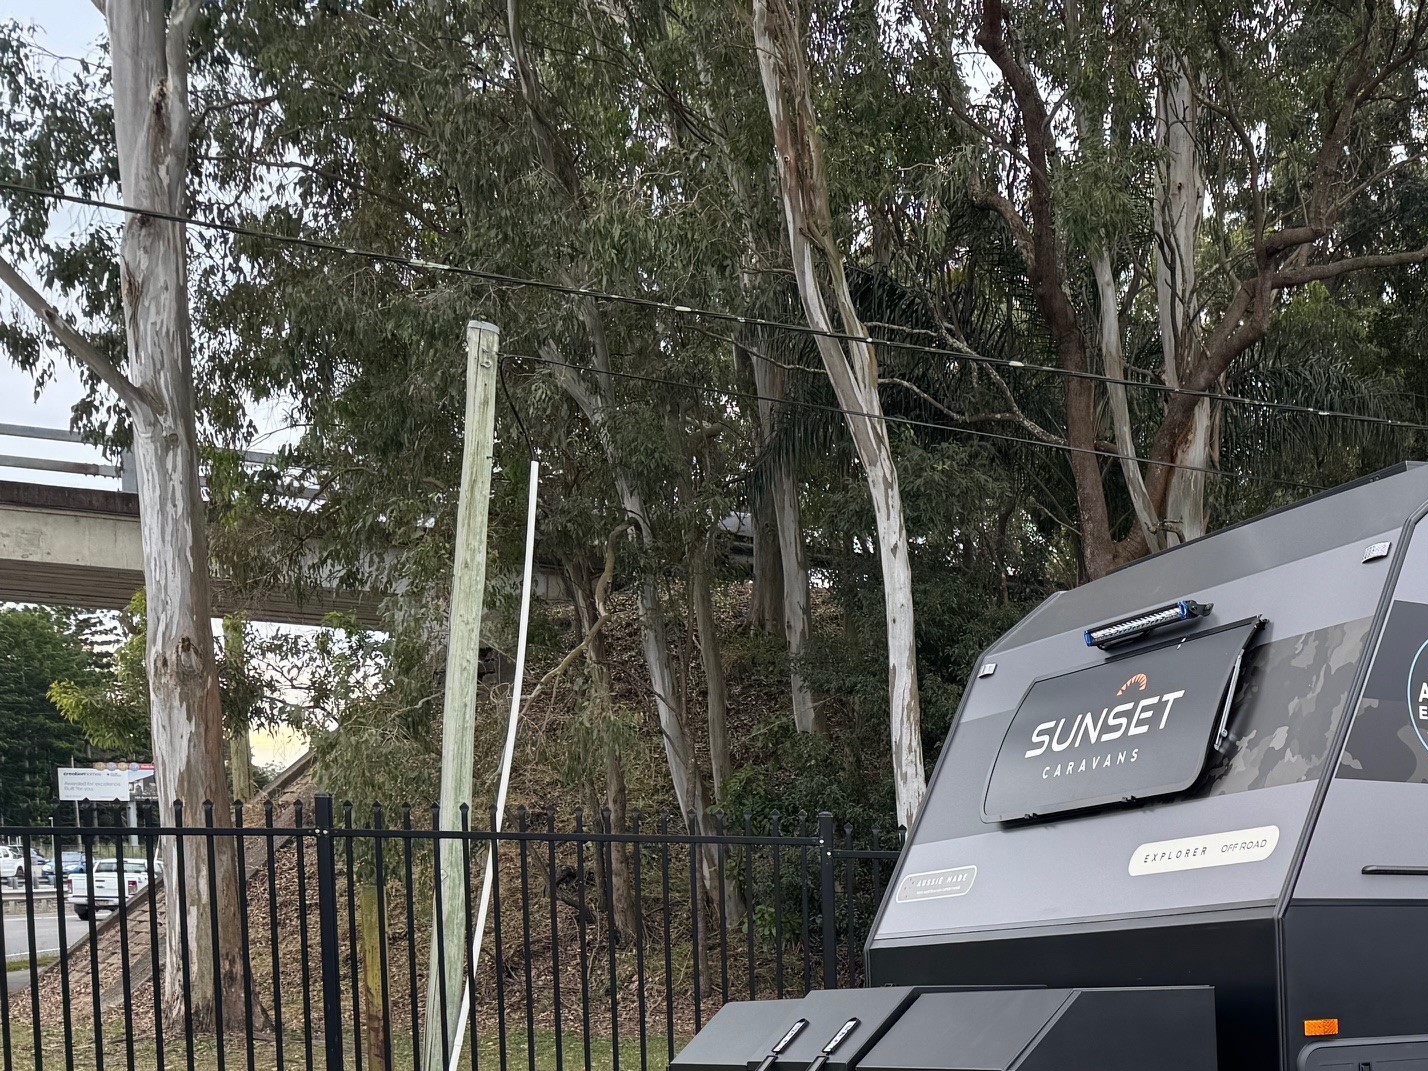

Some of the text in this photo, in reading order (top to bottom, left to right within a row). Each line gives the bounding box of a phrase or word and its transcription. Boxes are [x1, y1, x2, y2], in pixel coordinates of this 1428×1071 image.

[1024, 690, 1186, 758] SUNSET
[1042, 748, 1139, 779] CARAVANS
[1143, 846, 1208, 864] EXPLORER
[916, 873, 968, 888] AUSSIE MADE
